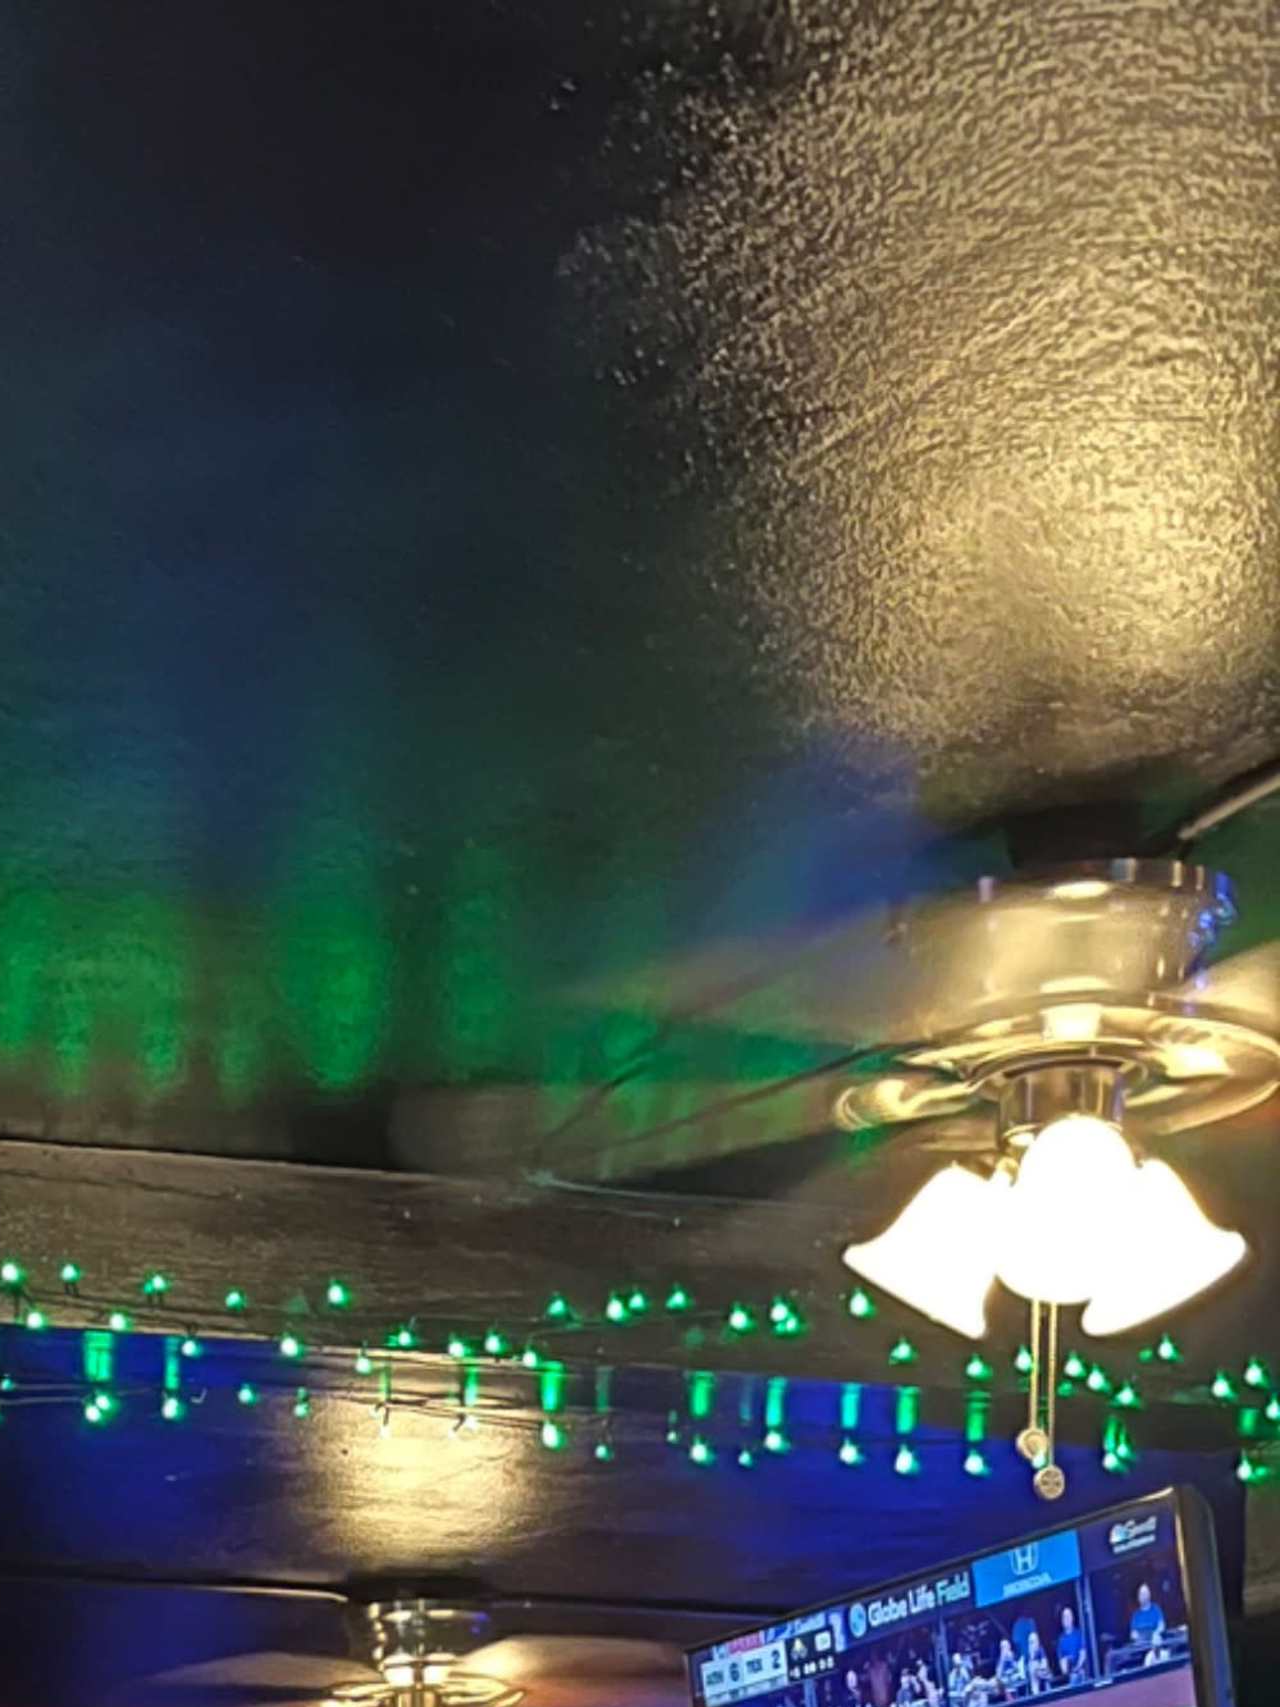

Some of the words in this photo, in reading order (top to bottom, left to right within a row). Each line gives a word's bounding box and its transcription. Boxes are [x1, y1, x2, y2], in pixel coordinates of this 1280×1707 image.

[868, 1597, 908, 1628] Globe
[909, 1581, 936, 1616] Life
[935, 1570, 971, 1609] Field
[770, 1649, 781, 1671] 2
